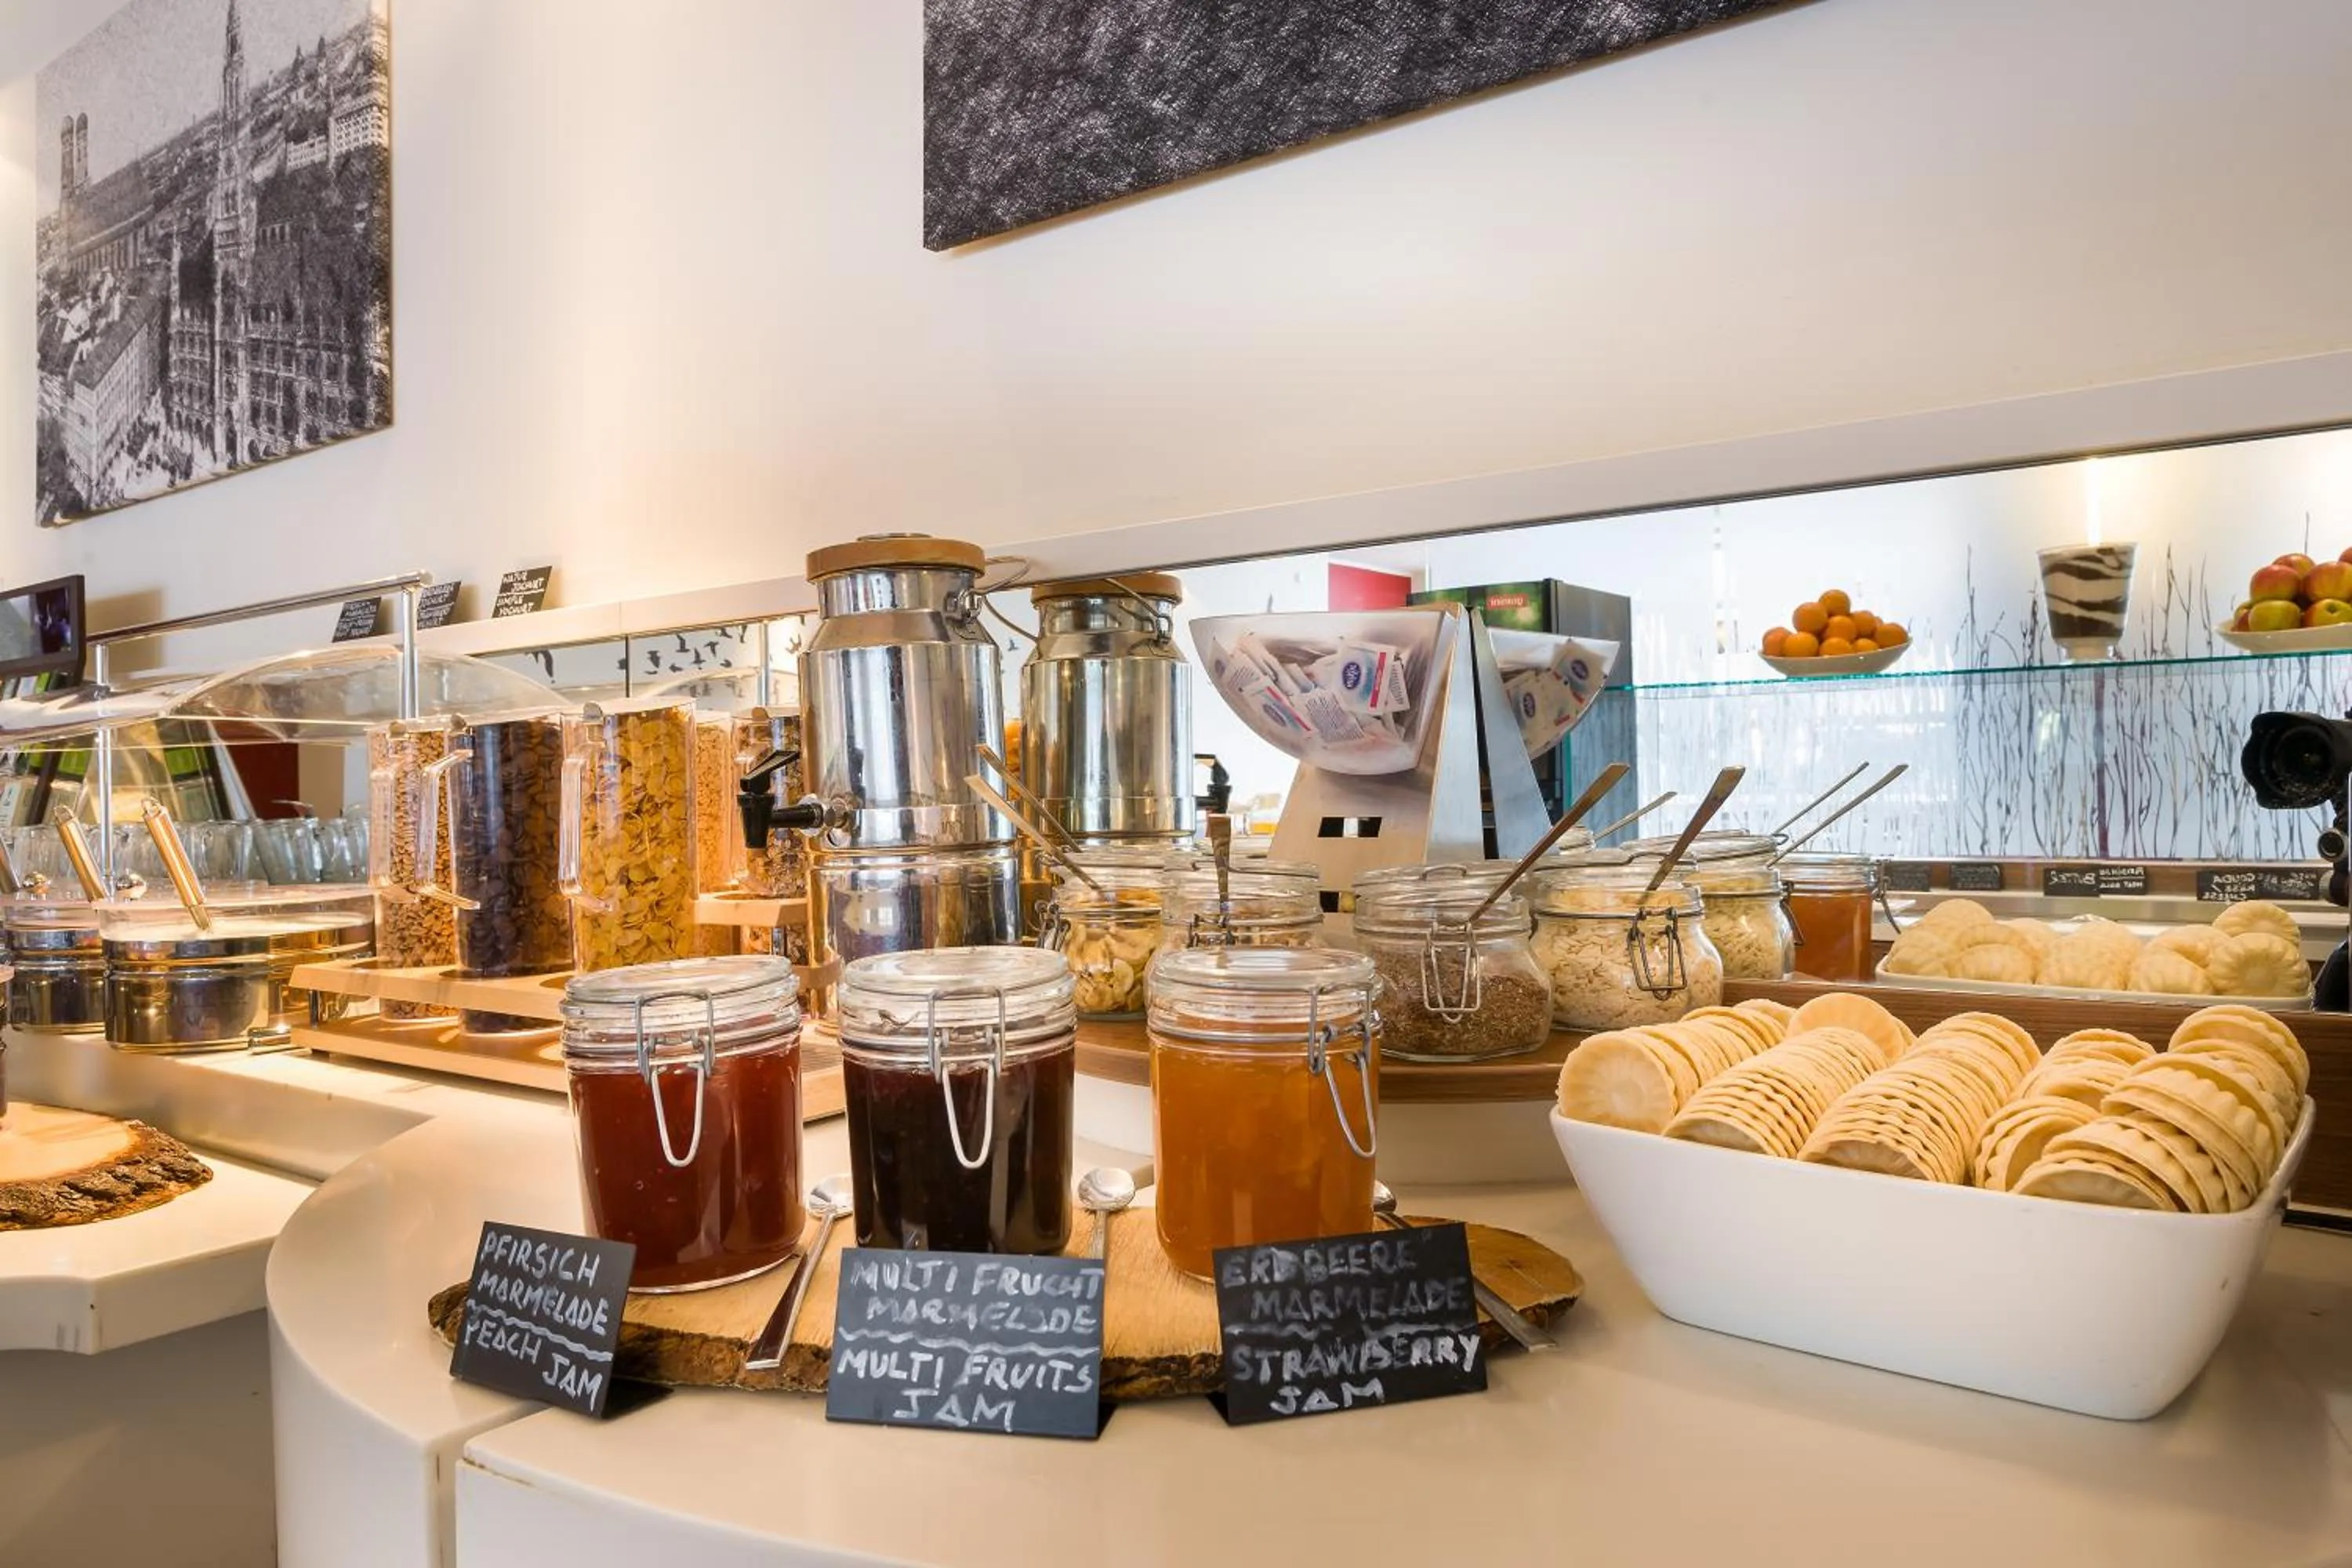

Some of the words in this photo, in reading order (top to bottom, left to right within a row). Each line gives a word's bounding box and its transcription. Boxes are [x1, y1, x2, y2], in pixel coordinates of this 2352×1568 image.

[479, 1230, 600, 1287] PFIRSICH
[851, 1258, 957, 1292] MULTI
[971, 1261, 1104, 1298] FRUCHT
[1222, 1240, 1417, 1288] ERDBEERE
[477, 1269, 609, 1336] MARMELADE
[1251, 1276, 1470, 1321] MARMELADE
[542, 1352, 603, 1411] JAM
[837, 1348, 943, 1388] MULTI
[953, 1354, 1094, 1393] FRUITS
[1231, 1333, 1480, 1385] STRAWBERRY
[892, 1388, 1016, 1432] JAM
[1269, 1377, 1385, 1414] JAM
